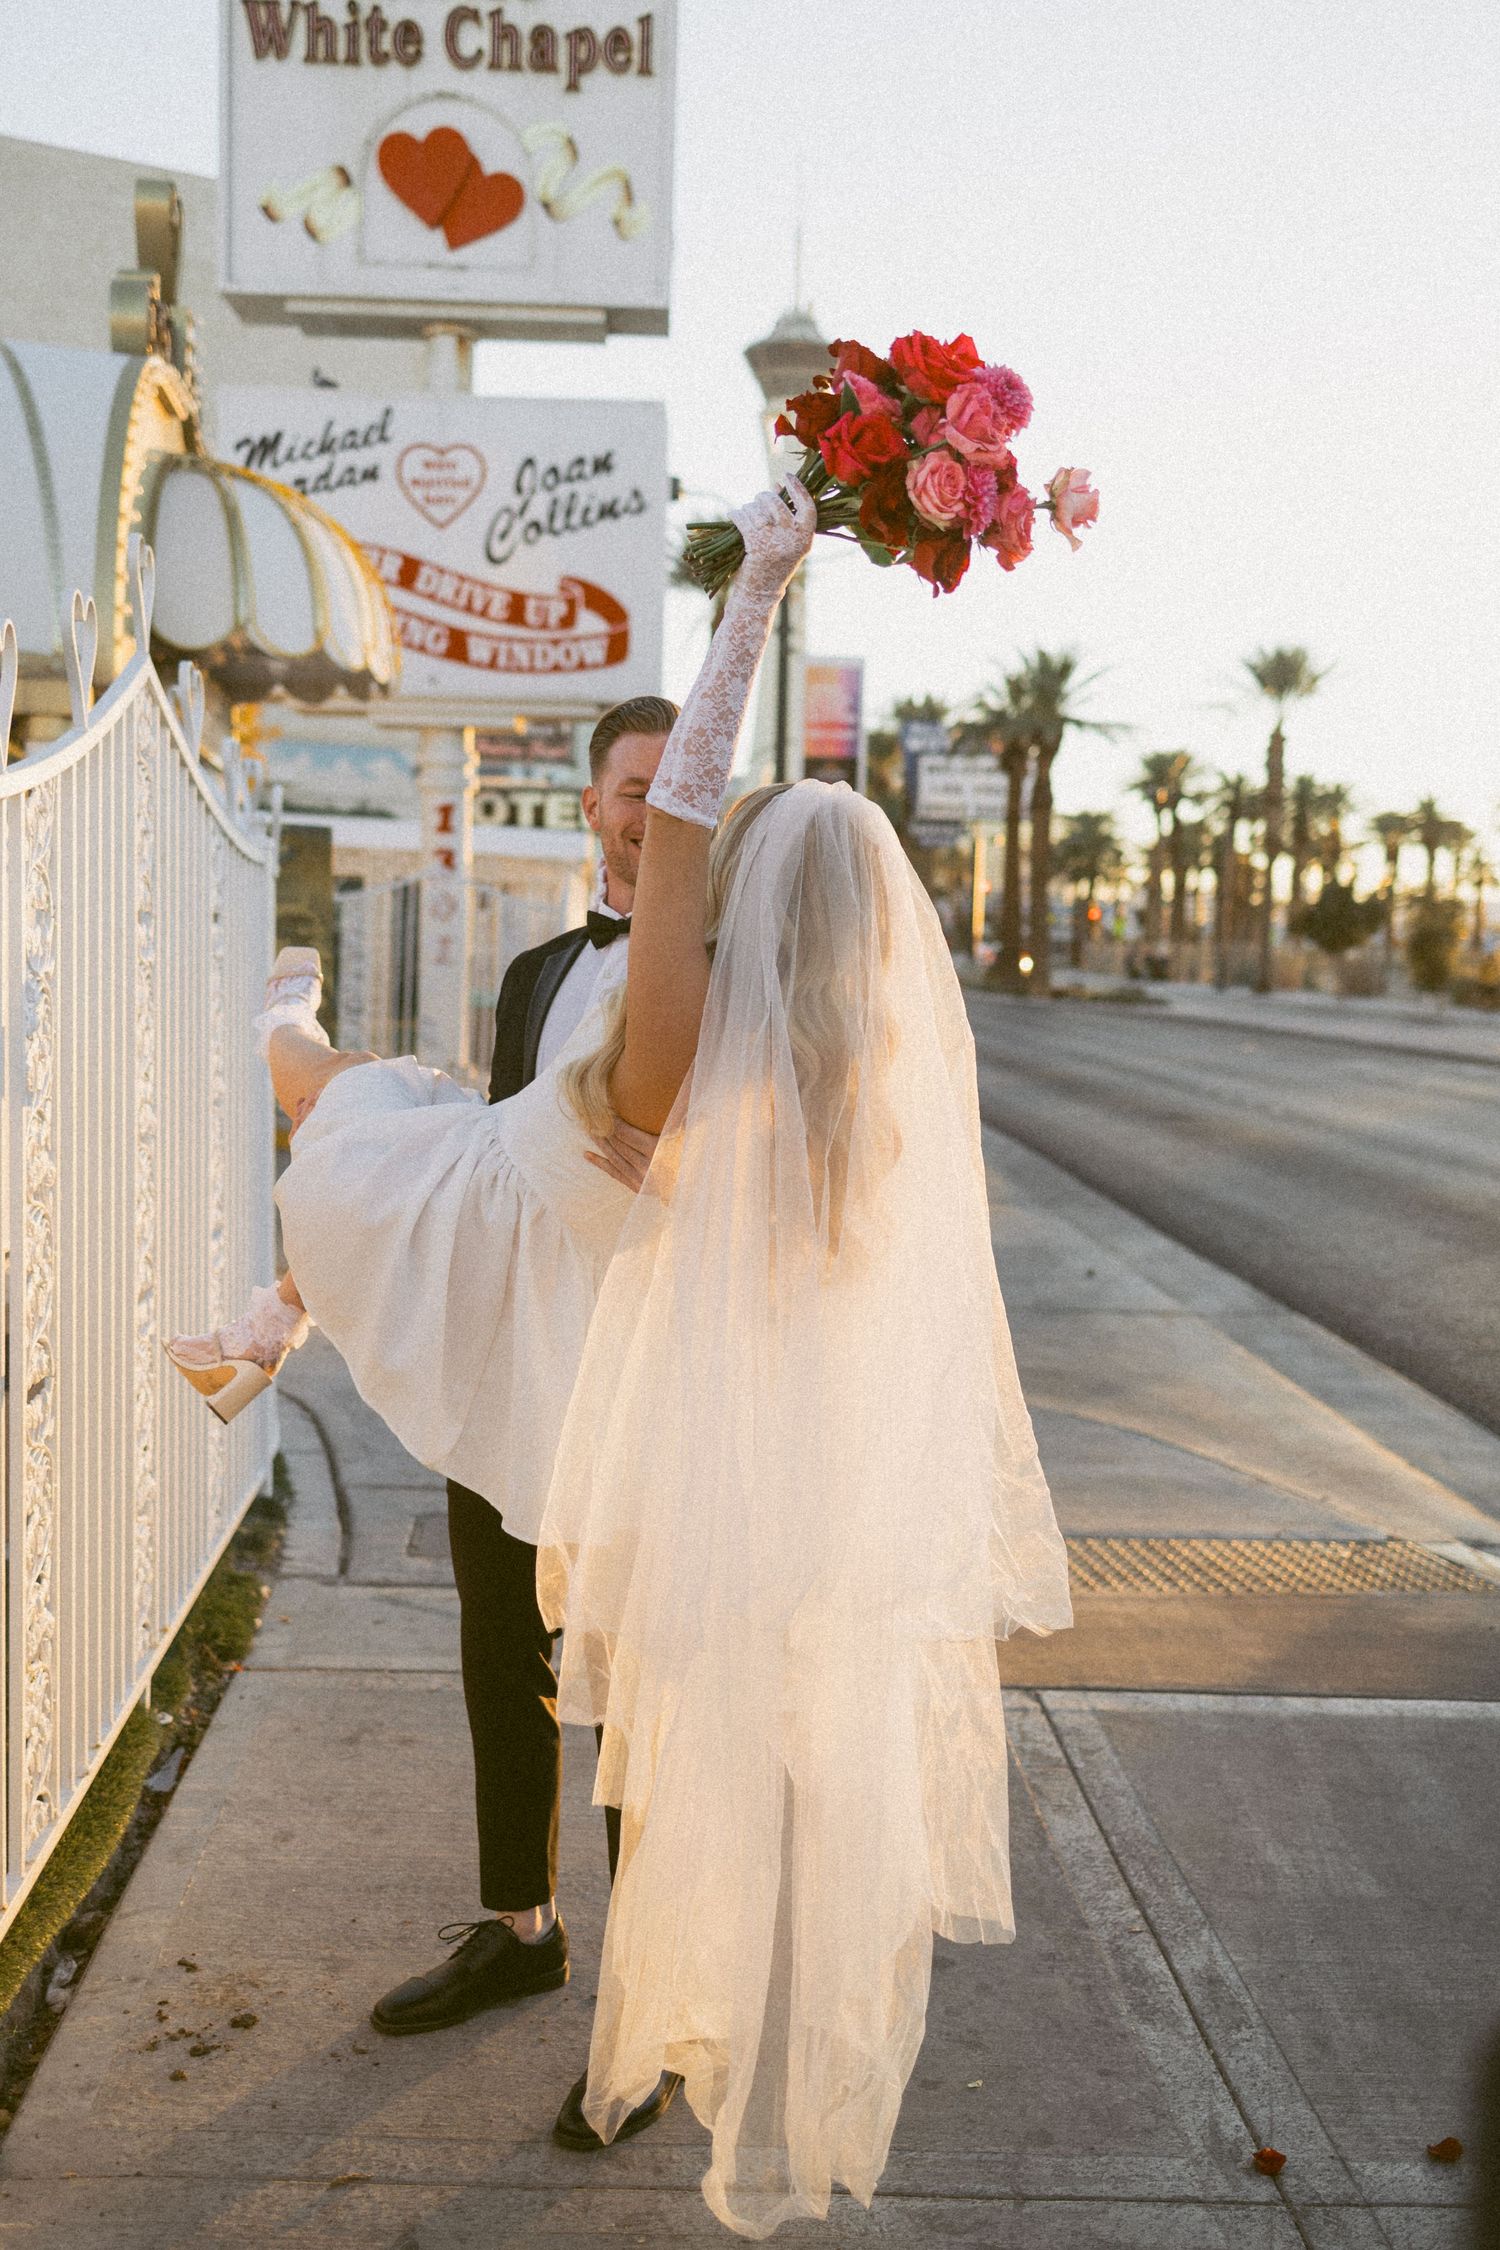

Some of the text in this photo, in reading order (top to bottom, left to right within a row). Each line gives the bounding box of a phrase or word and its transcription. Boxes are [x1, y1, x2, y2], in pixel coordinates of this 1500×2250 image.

[242, 0, 654, 93] White Chapel
[235, 405, 394, 469] Michael
[293, 461, 381, 496] rdan
[514, 451, 614, 519] Joan
[485, 488, 646, 564] Collins
[413, 563, 513, 622] DRIVE
[524, 597, 570, 630] UP
[399, 613, 610, 671] NG WINDOW
[474, 792, 580, 829] OTE
